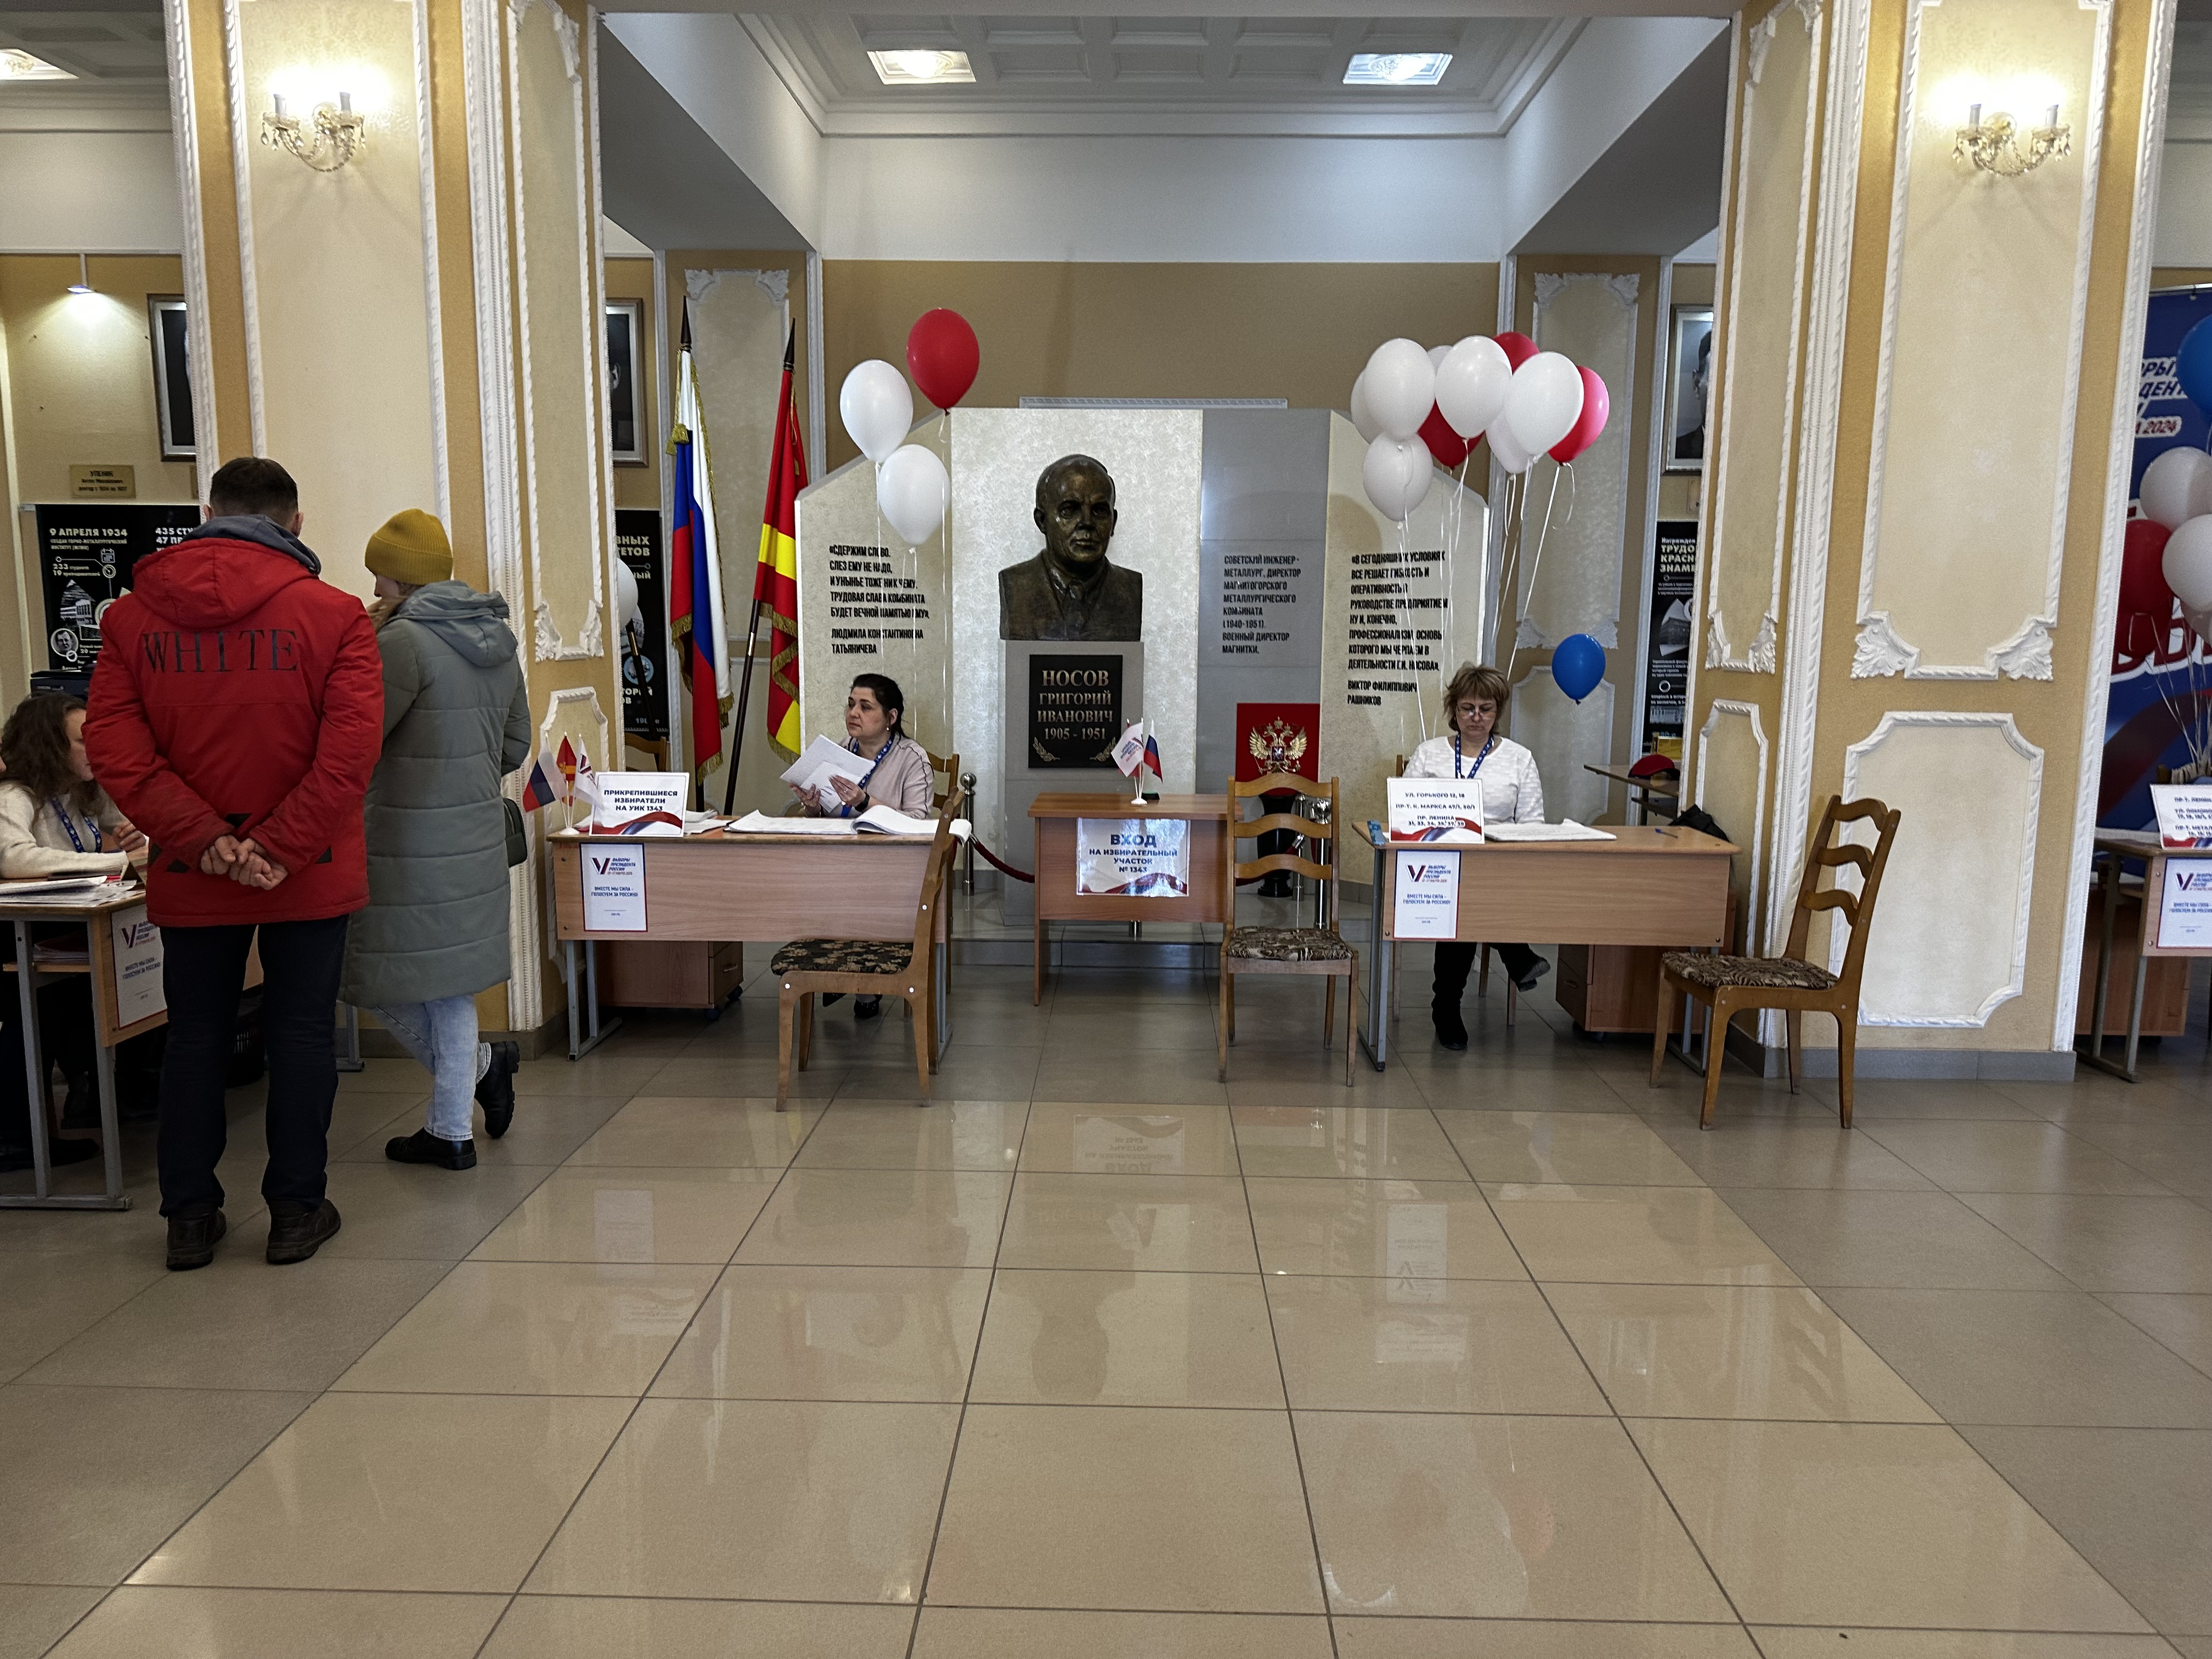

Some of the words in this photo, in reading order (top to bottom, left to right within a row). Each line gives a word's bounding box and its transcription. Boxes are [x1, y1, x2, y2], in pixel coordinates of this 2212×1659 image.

[2141, 361, 2176, 377] РЫ
[102, 528, 128, 537] 1934
[1224, 554, 1262, 565] СОВЕТСКИЙ
[830, 560, 847, 571] СЛЕЗ
[848, 561, 862, 571] ЕМУ
[863, 561, 872, 572] НЕ
[1224, 568, 1265, 578] МЕТАЛЛУРГ,
[1267, 568, 1301, 578] ДИРЕКТОР
[1351, 569, 1363, 579] ВСЕ
[1364, 568, 1390, 579] РЕШАЕТ
[1424, 566, 1429, 577] И
[830, 575, 835, 586] И
[836, 576, 864, 587] УНЫНЬЕ
[865, 577, 882, 588] ТОЖЕ
[1223, 581, 1288, 590] МАГНИТОГОРСКОГО
[1351, 583, 1402, 594] ОПЕРАТИВНОСТЬ
[830, 591, 865, 603] ТРУДОВАЯ
[866, 592, 887, 603] СЛАВА
[888, 594, 926, 604] КОМБИНАТА
[1223, 594, 1296, 603] МЕТАЛЛУРГИЧЕСКОГО
[1350, 599, 1394, 610] РУКОВОДСТВЕ
[831, 606, 852, 618] БУДЕТ
[854, 606, 879, 618] ВЕЧНОЙ
[880, 607, 911, 618] ПАМЯТЬЮ
[1223, 607, 1263, 616] КОМБИНАТА
[1350, 614, 1358, 624] НУ
[1367, 614, 1397, 625] КОНЕЧНО,
[831, 628, 867, 640] ЛЮДМИЛА
[867, 629, 924, 639] КОНСТАНТИНОВНА
[1222, 631, 1254, 641] ВОЕННЫЙ
[1255, 632, 1290, 642] ДИРЕКТОР
[143, 629, 298, 673] WHITE
[831, 644, 878, 654] ТАТЬЯНИЧЕВА
[1222, 645, 1260, 654] МАГНИТКИ.
[1348, 644, 1379, 654] КОТОРОГО
[1380, 645, 1392, 654] МЫ
[1393, 645, 1424, 656] ЧЕРПАЕМ
[1425, 645, 1429, 656] В
[1348, 659, 1396, 670] ДЕЯТЕЛЬНОСТИ
[1042, 669, 1109, 687] НОСОВ
[1348, 680, 1371, 691] ВИКТОР
[1372, 680, 1417, 692] ФИЛИППОВИЧ
[1039, 690, 1111, 705] ГРИГОРИЙ
[1347, 695, 1381, 706] РАШНИКОВ
[1037, 710, 1113, 723] ИВАНОВИЧ
[1045, 727, 1070, 740] 1905
[1081, 727, 1106, 740] 1951
[1110, 834, 1157, 848] ВХОД
